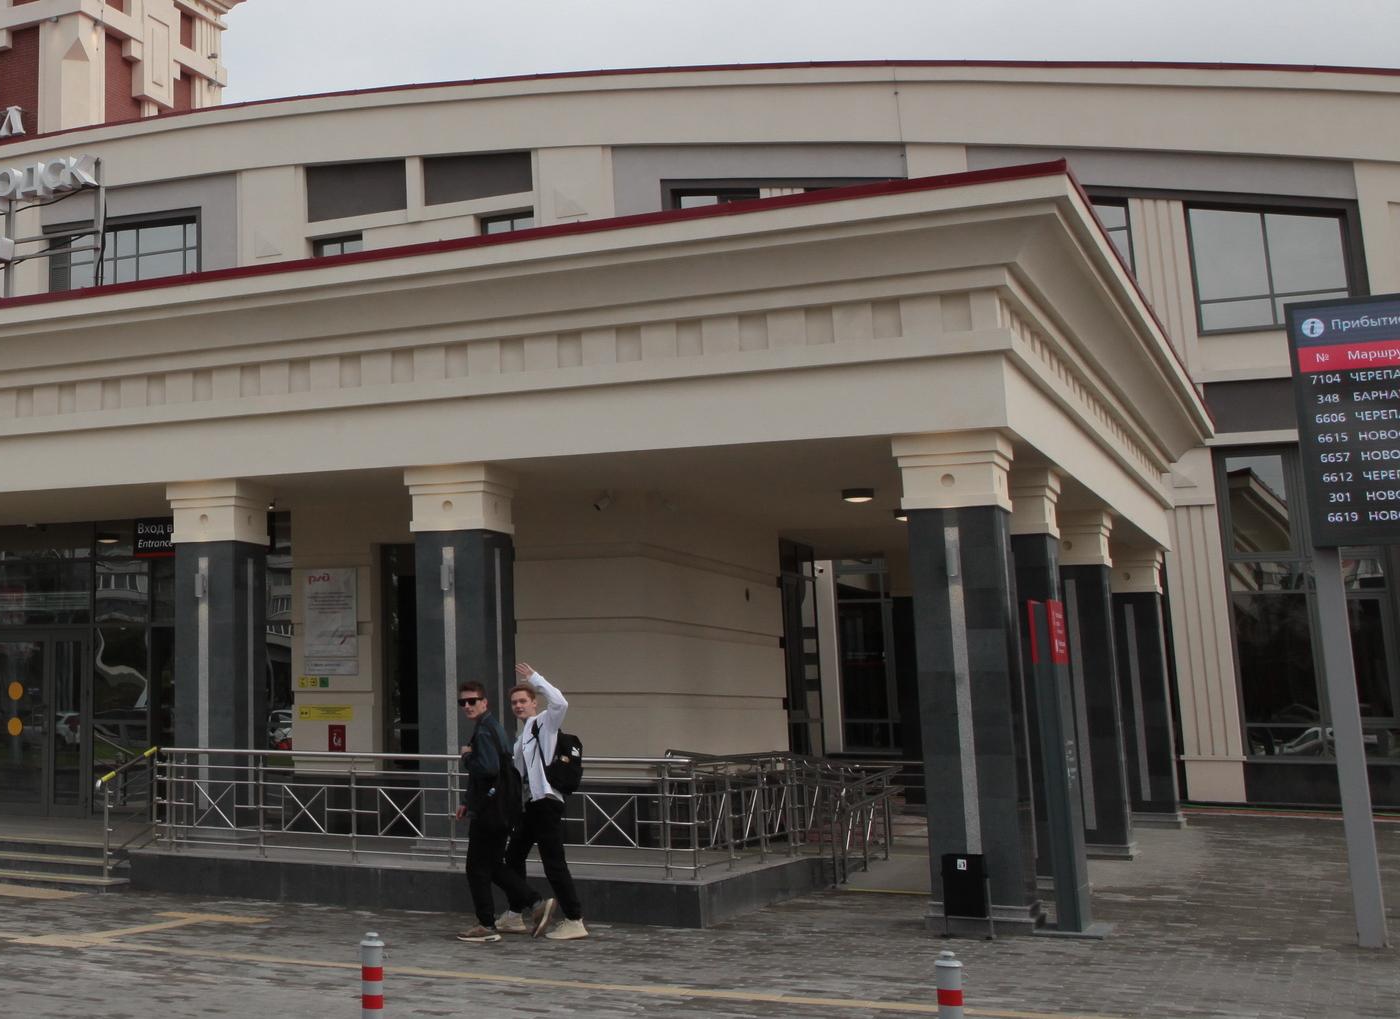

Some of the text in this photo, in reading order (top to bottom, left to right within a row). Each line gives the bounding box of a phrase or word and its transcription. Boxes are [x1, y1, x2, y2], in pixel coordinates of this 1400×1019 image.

[1310, 373, 1341, 385] 7104
[1317, 389, 1400, 404] 348 БАРНА
[1315, 409, 1400, 423] 6606 ЧЕРЕП
[1318, 429, 1400, 443] 6615 НОВО
[1320, 452, 1350, 463] 6657
[1322, 471, 1353, 483] 6612
[1329, 492, 1351, 503] 301
[1327, 510, 1400, 523] 6619 НОВ
[138, 523, 165, 535] Вход
